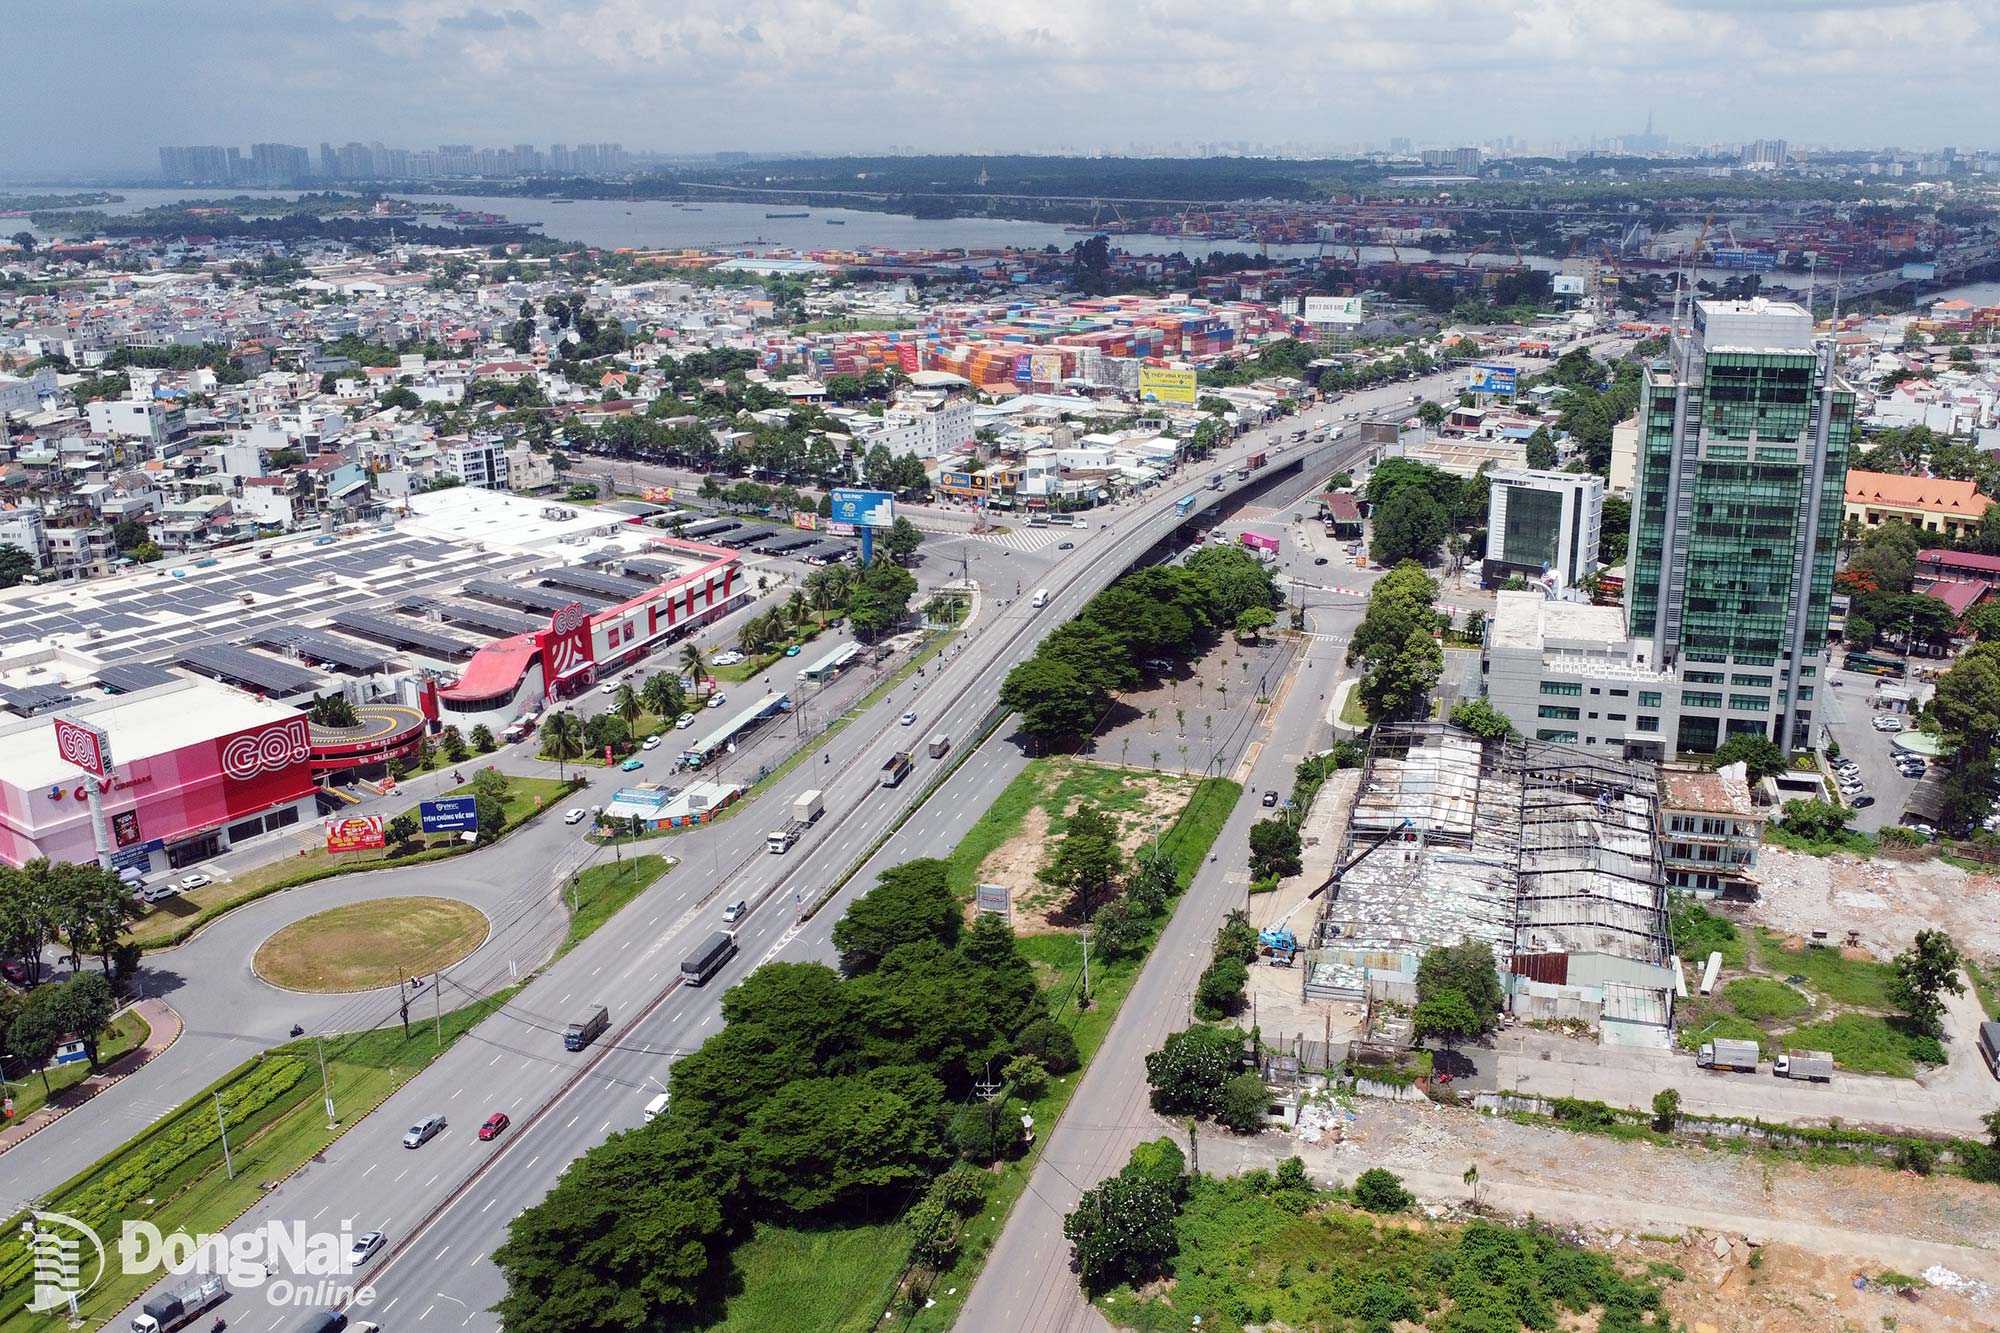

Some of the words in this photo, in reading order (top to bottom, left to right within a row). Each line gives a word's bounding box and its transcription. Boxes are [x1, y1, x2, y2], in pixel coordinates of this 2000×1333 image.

[554, 602, 583, 636] GO!
[59, 724, 98, 770] GO!
[222, 719, 310, 781] GO!
